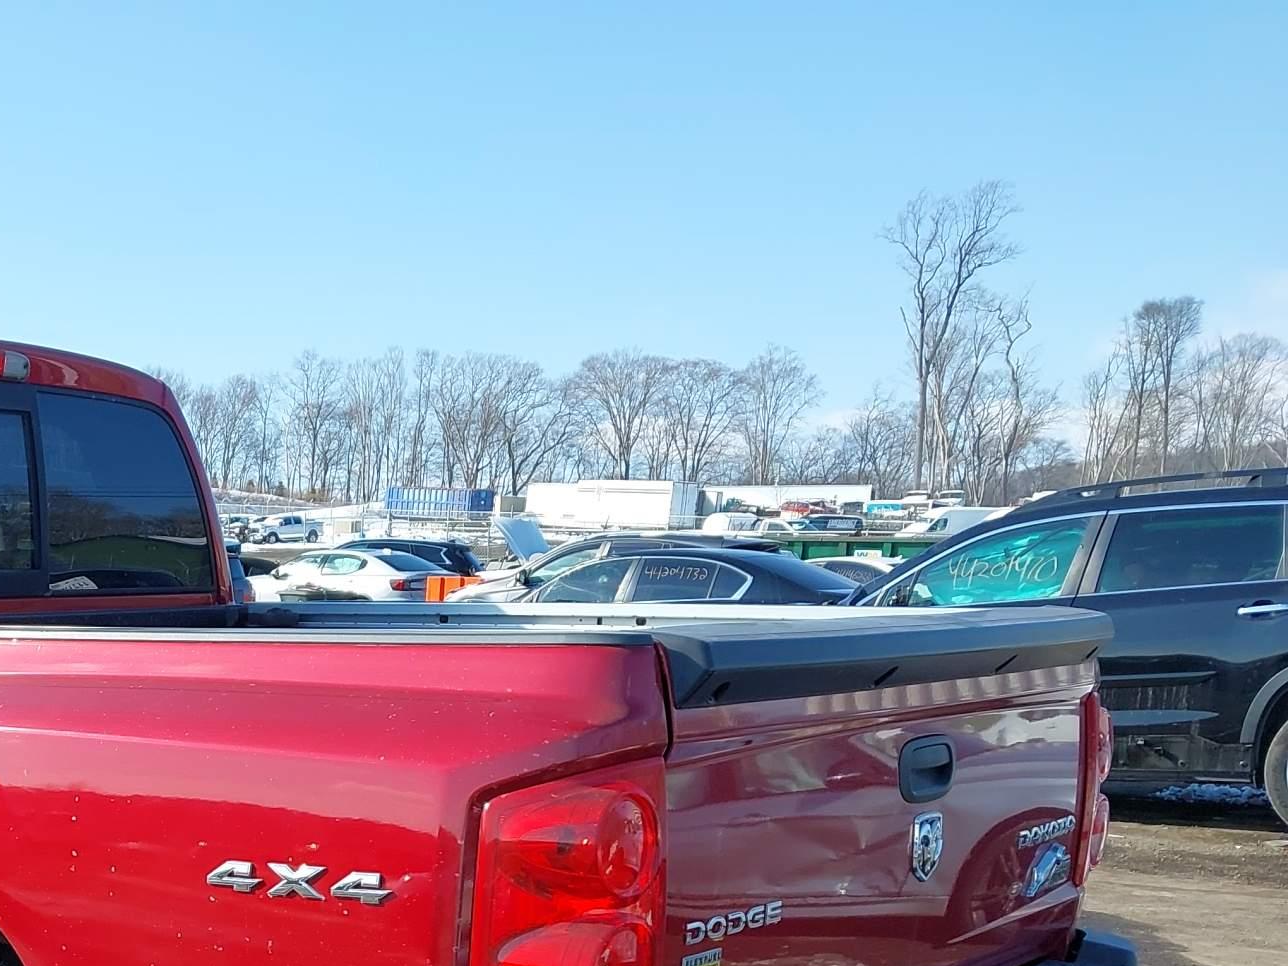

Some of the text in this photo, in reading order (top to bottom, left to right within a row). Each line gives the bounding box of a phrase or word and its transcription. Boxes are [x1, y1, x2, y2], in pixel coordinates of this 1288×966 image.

[645, 566, 708, 580] 44204732
[1016, 815, 1076, 850] DAKOTA
[206, 860, 394, 904] 4X4
[685, 900, 783, 946] DODGE
